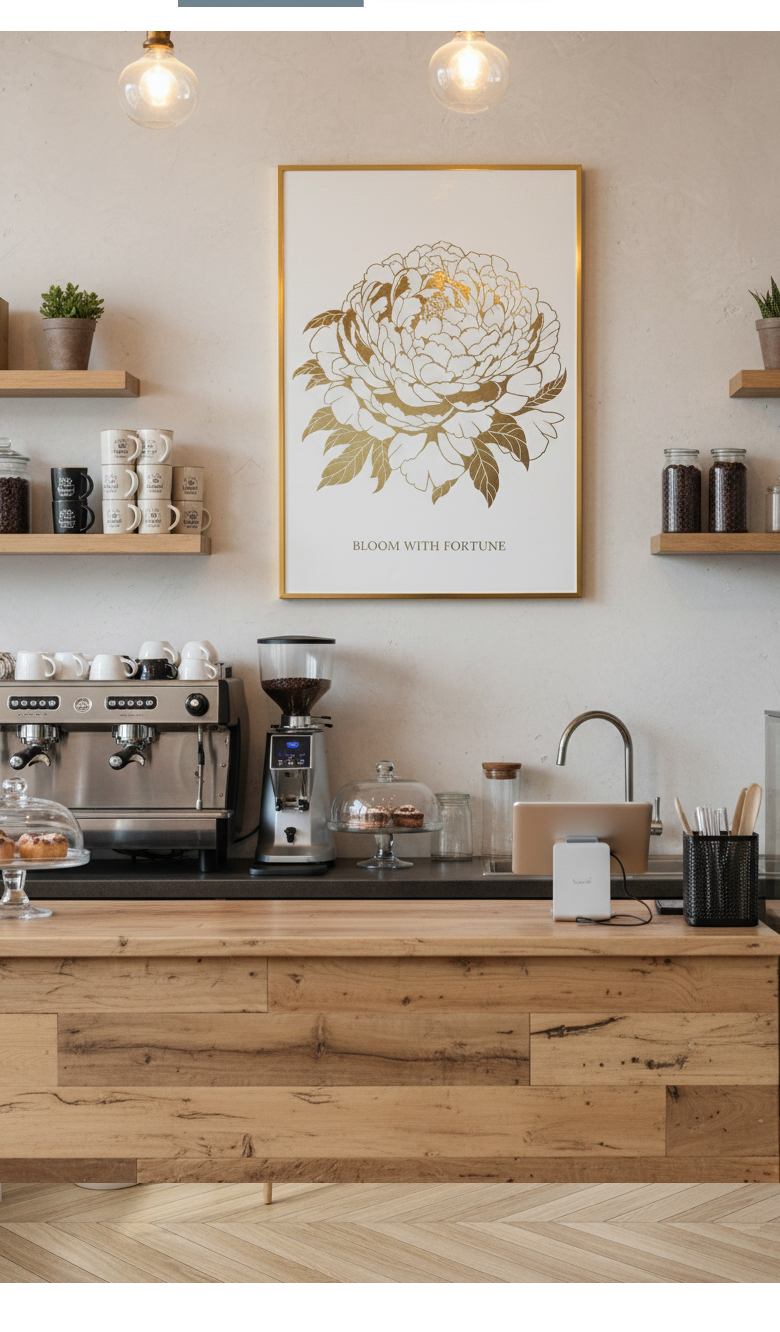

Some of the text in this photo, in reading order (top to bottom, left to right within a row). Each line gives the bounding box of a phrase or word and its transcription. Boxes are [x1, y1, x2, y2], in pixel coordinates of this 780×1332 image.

[353, 540, 506, 552] BLOOM WITH FORTUNE
